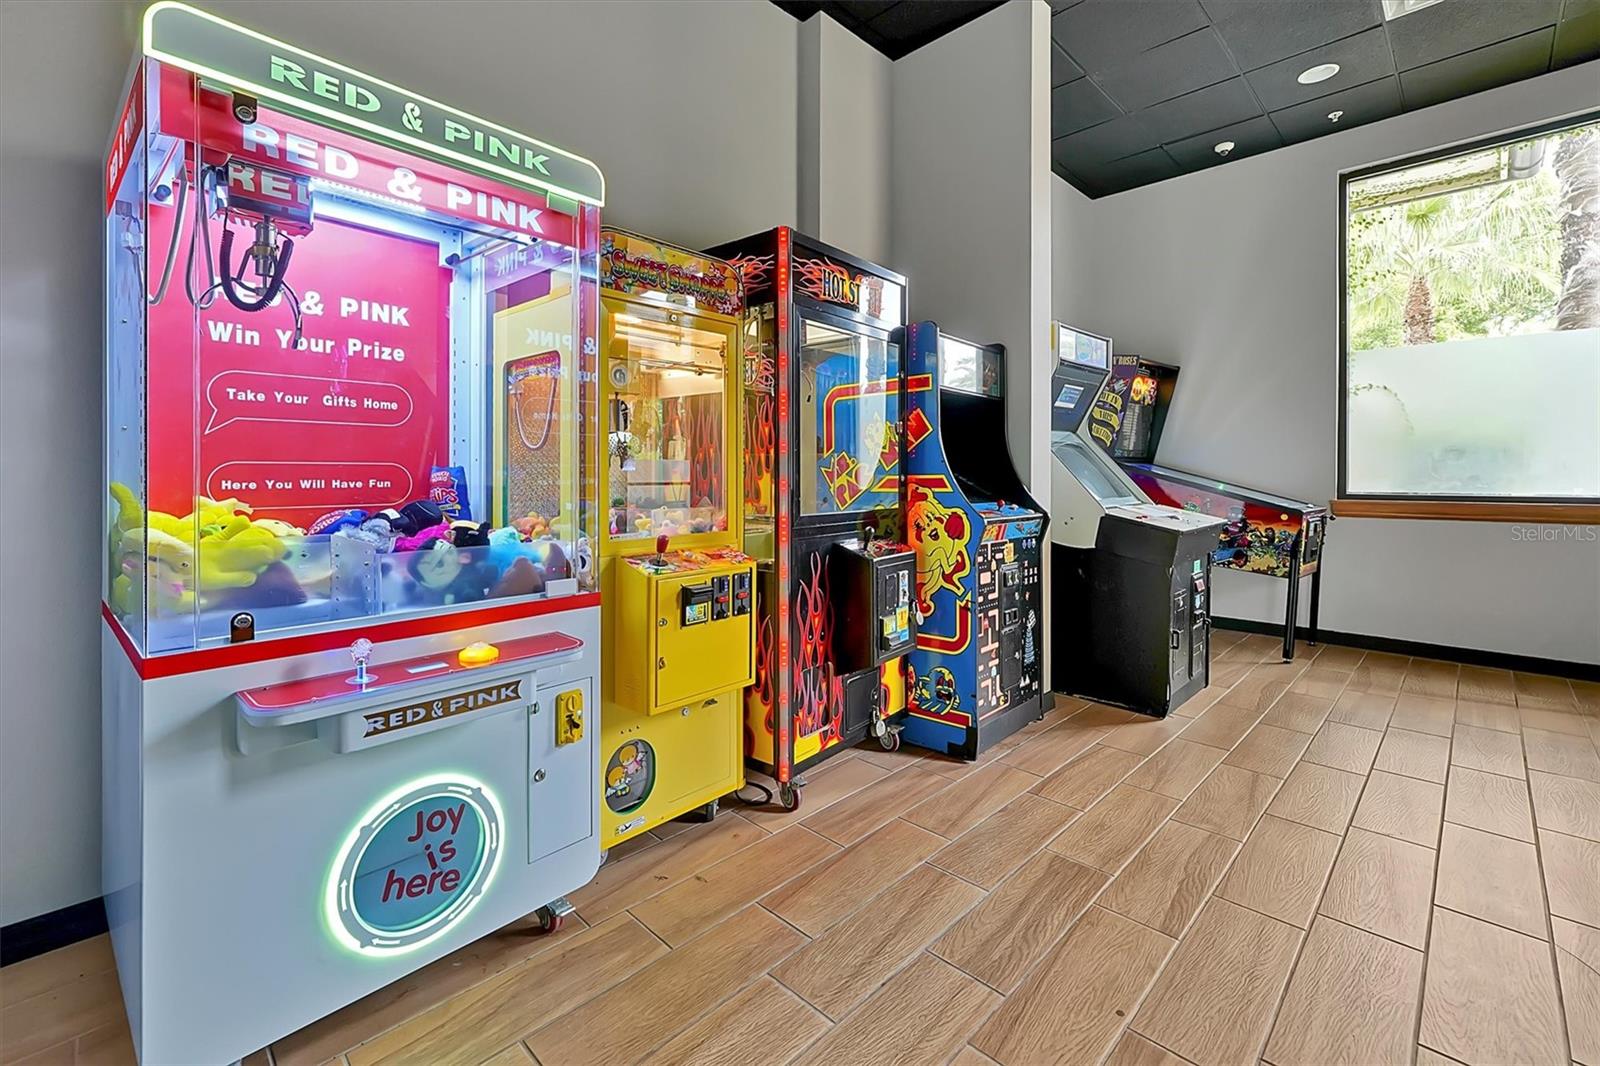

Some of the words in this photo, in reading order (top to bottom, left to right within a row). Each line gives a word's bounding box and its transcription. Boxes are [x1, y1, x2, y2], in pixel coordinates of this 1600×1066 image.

[270, 55, 382, 114] RED
[402, 101, 423, 134] &
[444, 119, 550, 176] PINK
[242, 123, 359, 180] RED
[386, 168, 423, 202] &
[446, 185, 544, 233] PINK
[822, 267, 847, 301] HOT
[300, 290, 324, 317] &
[340, 297, 410, 327] PINK
[207, 320, 260, 346] Win
[275, 328, 335, 355] Your
[348, 338, 406, 362] Prize
[226, 387, 266, 403] Take
[274, 391, 310, 406] Your
[322, 393, 357, 409] Gifts
[363, 397, 399, 411] Home
[221, 479, 258, 491] Here
[264, 479, 293, 491] You
[299, 477, 326, 490] Will
[331, 477, 363, 489] Have
[367, 477, 392, 489] Fun
[367, 705, 426, 733] RED
[430, 700, 444, 719] &
[450, 686, 520, 711] PINK
[408, 803, 466, 843] Joy
[425, 838, 457, 871] is
[381, 868, 461, 904] here
